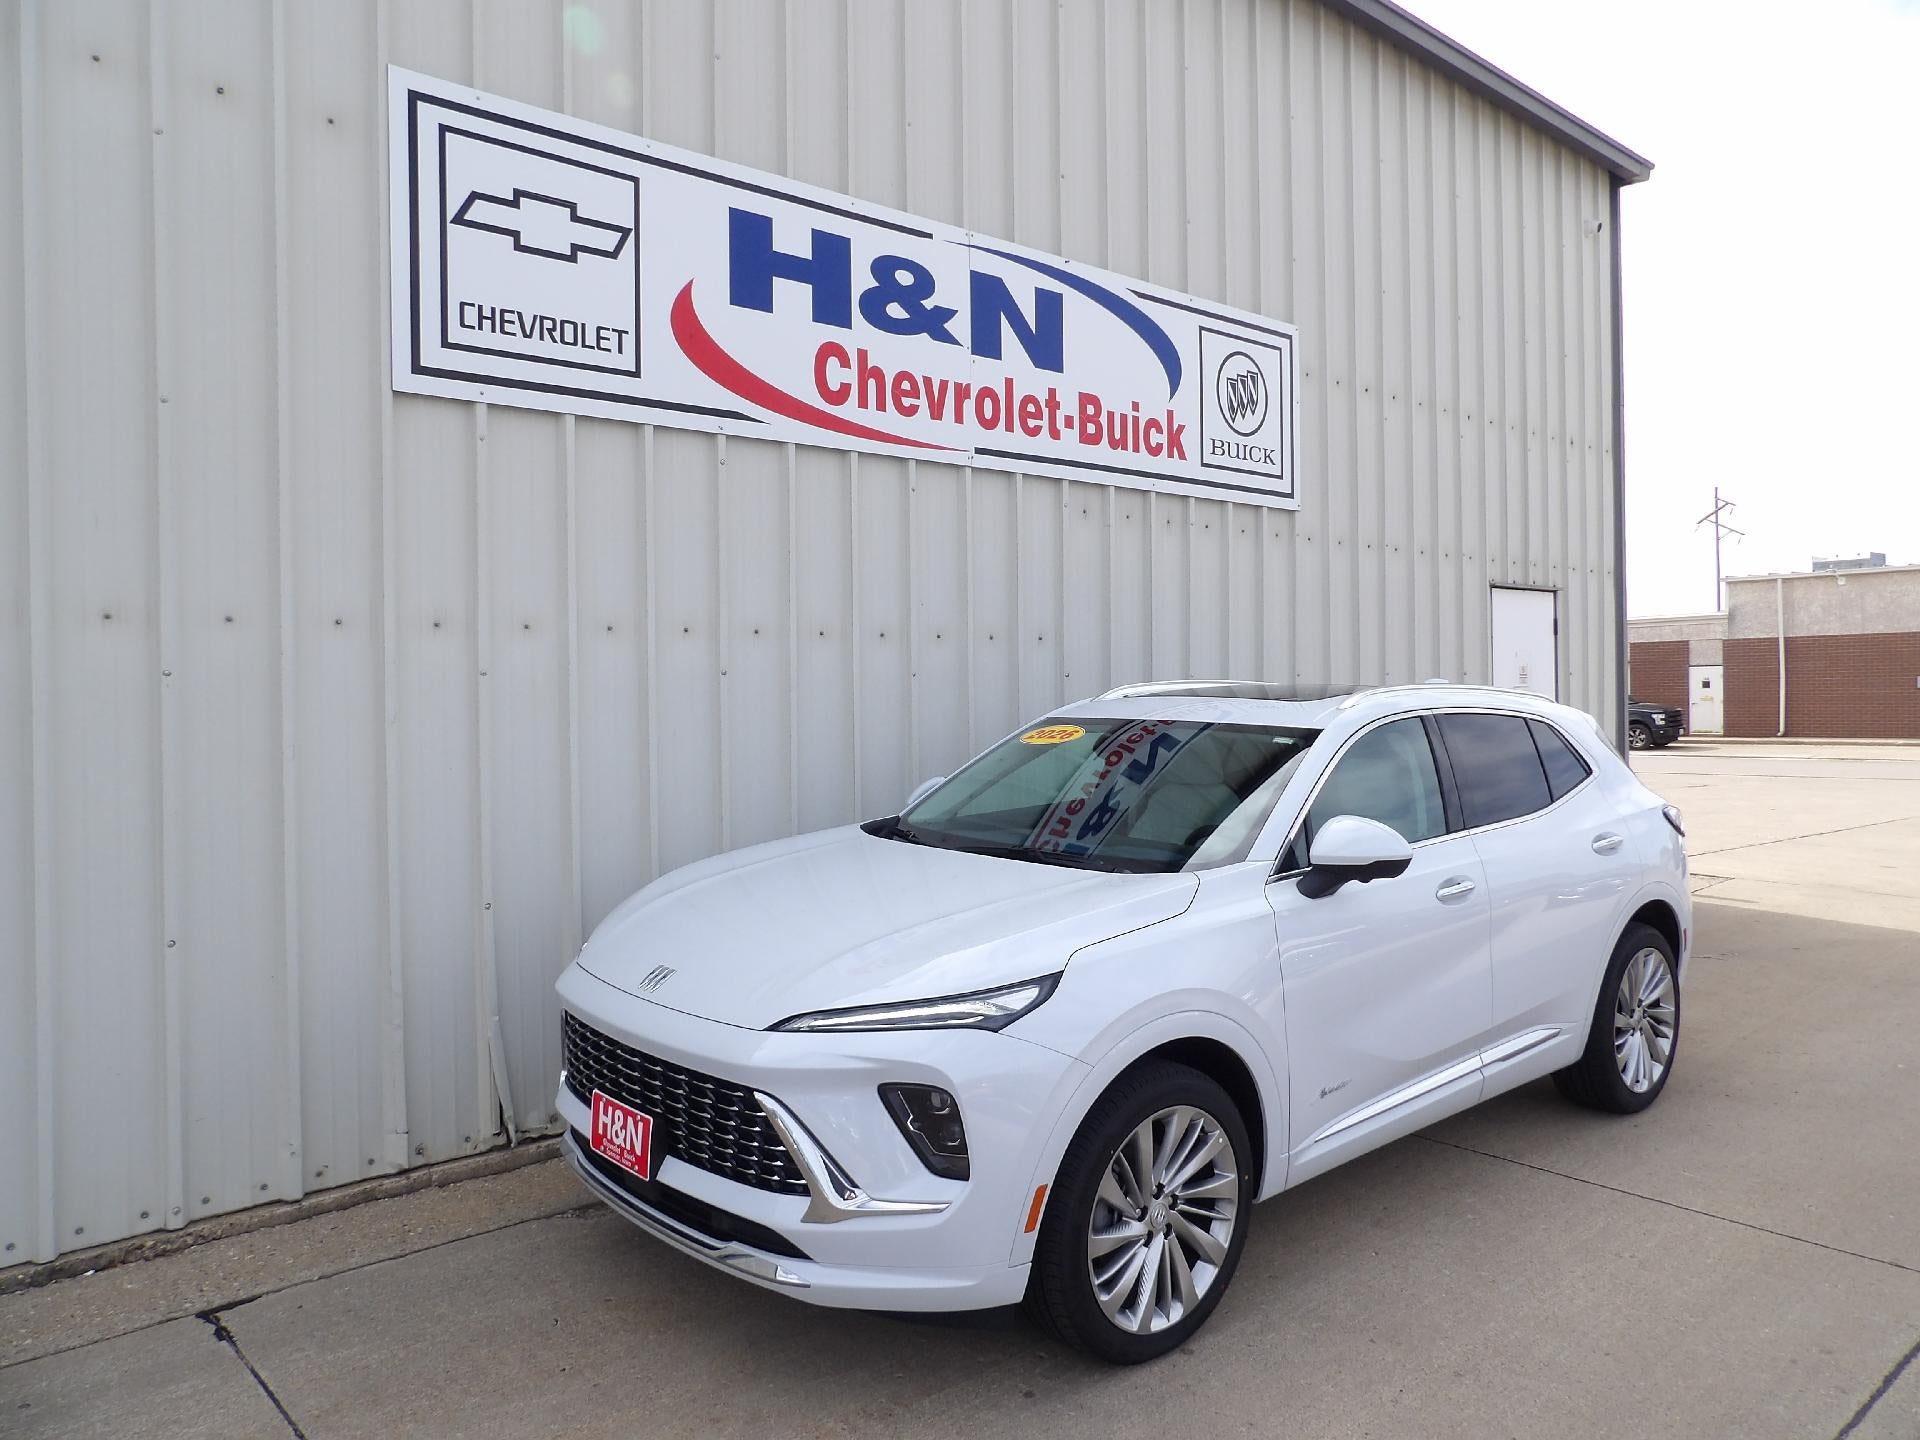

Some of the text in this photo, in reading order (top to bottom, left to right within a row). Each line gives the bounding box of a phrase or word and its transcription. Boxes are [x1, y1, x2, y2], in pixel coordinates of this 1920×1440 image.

[729, 206, 1065, 374] H&N
[458, 301, 629, 355] CHEVROLET
[813, 340, 1188, 462] Chevrolet-Buick
[1210, 437, 1277, 467] BUICK
[598, 1101, 644, 1156] H&N
